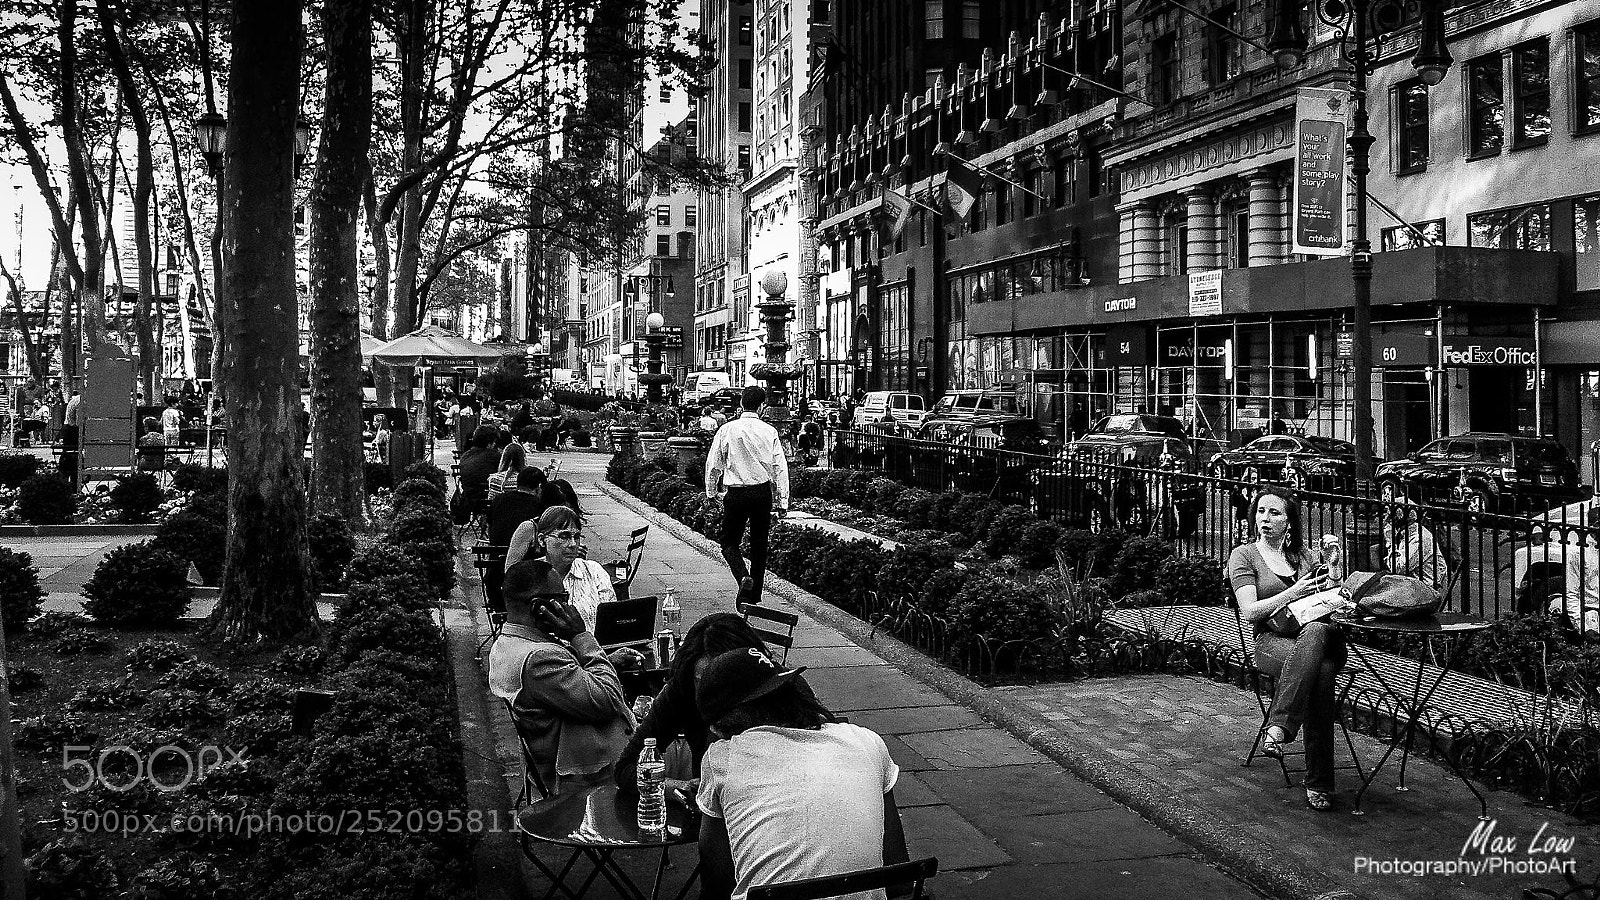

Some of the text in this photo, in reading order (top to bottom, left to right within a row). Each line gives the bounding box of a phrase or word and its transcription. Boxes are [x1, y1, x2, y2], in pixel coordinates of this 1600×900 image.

[1302, 170, 1340, 181] some play
[1302, 178, 1326, 188] story?
[1308, 234, 1338, 243] citibank
[1120, 341, 1130, 354] 54
[1168, 345, 1225, 358] DAYTOP
[1383, 347, 1397, 361] 60
